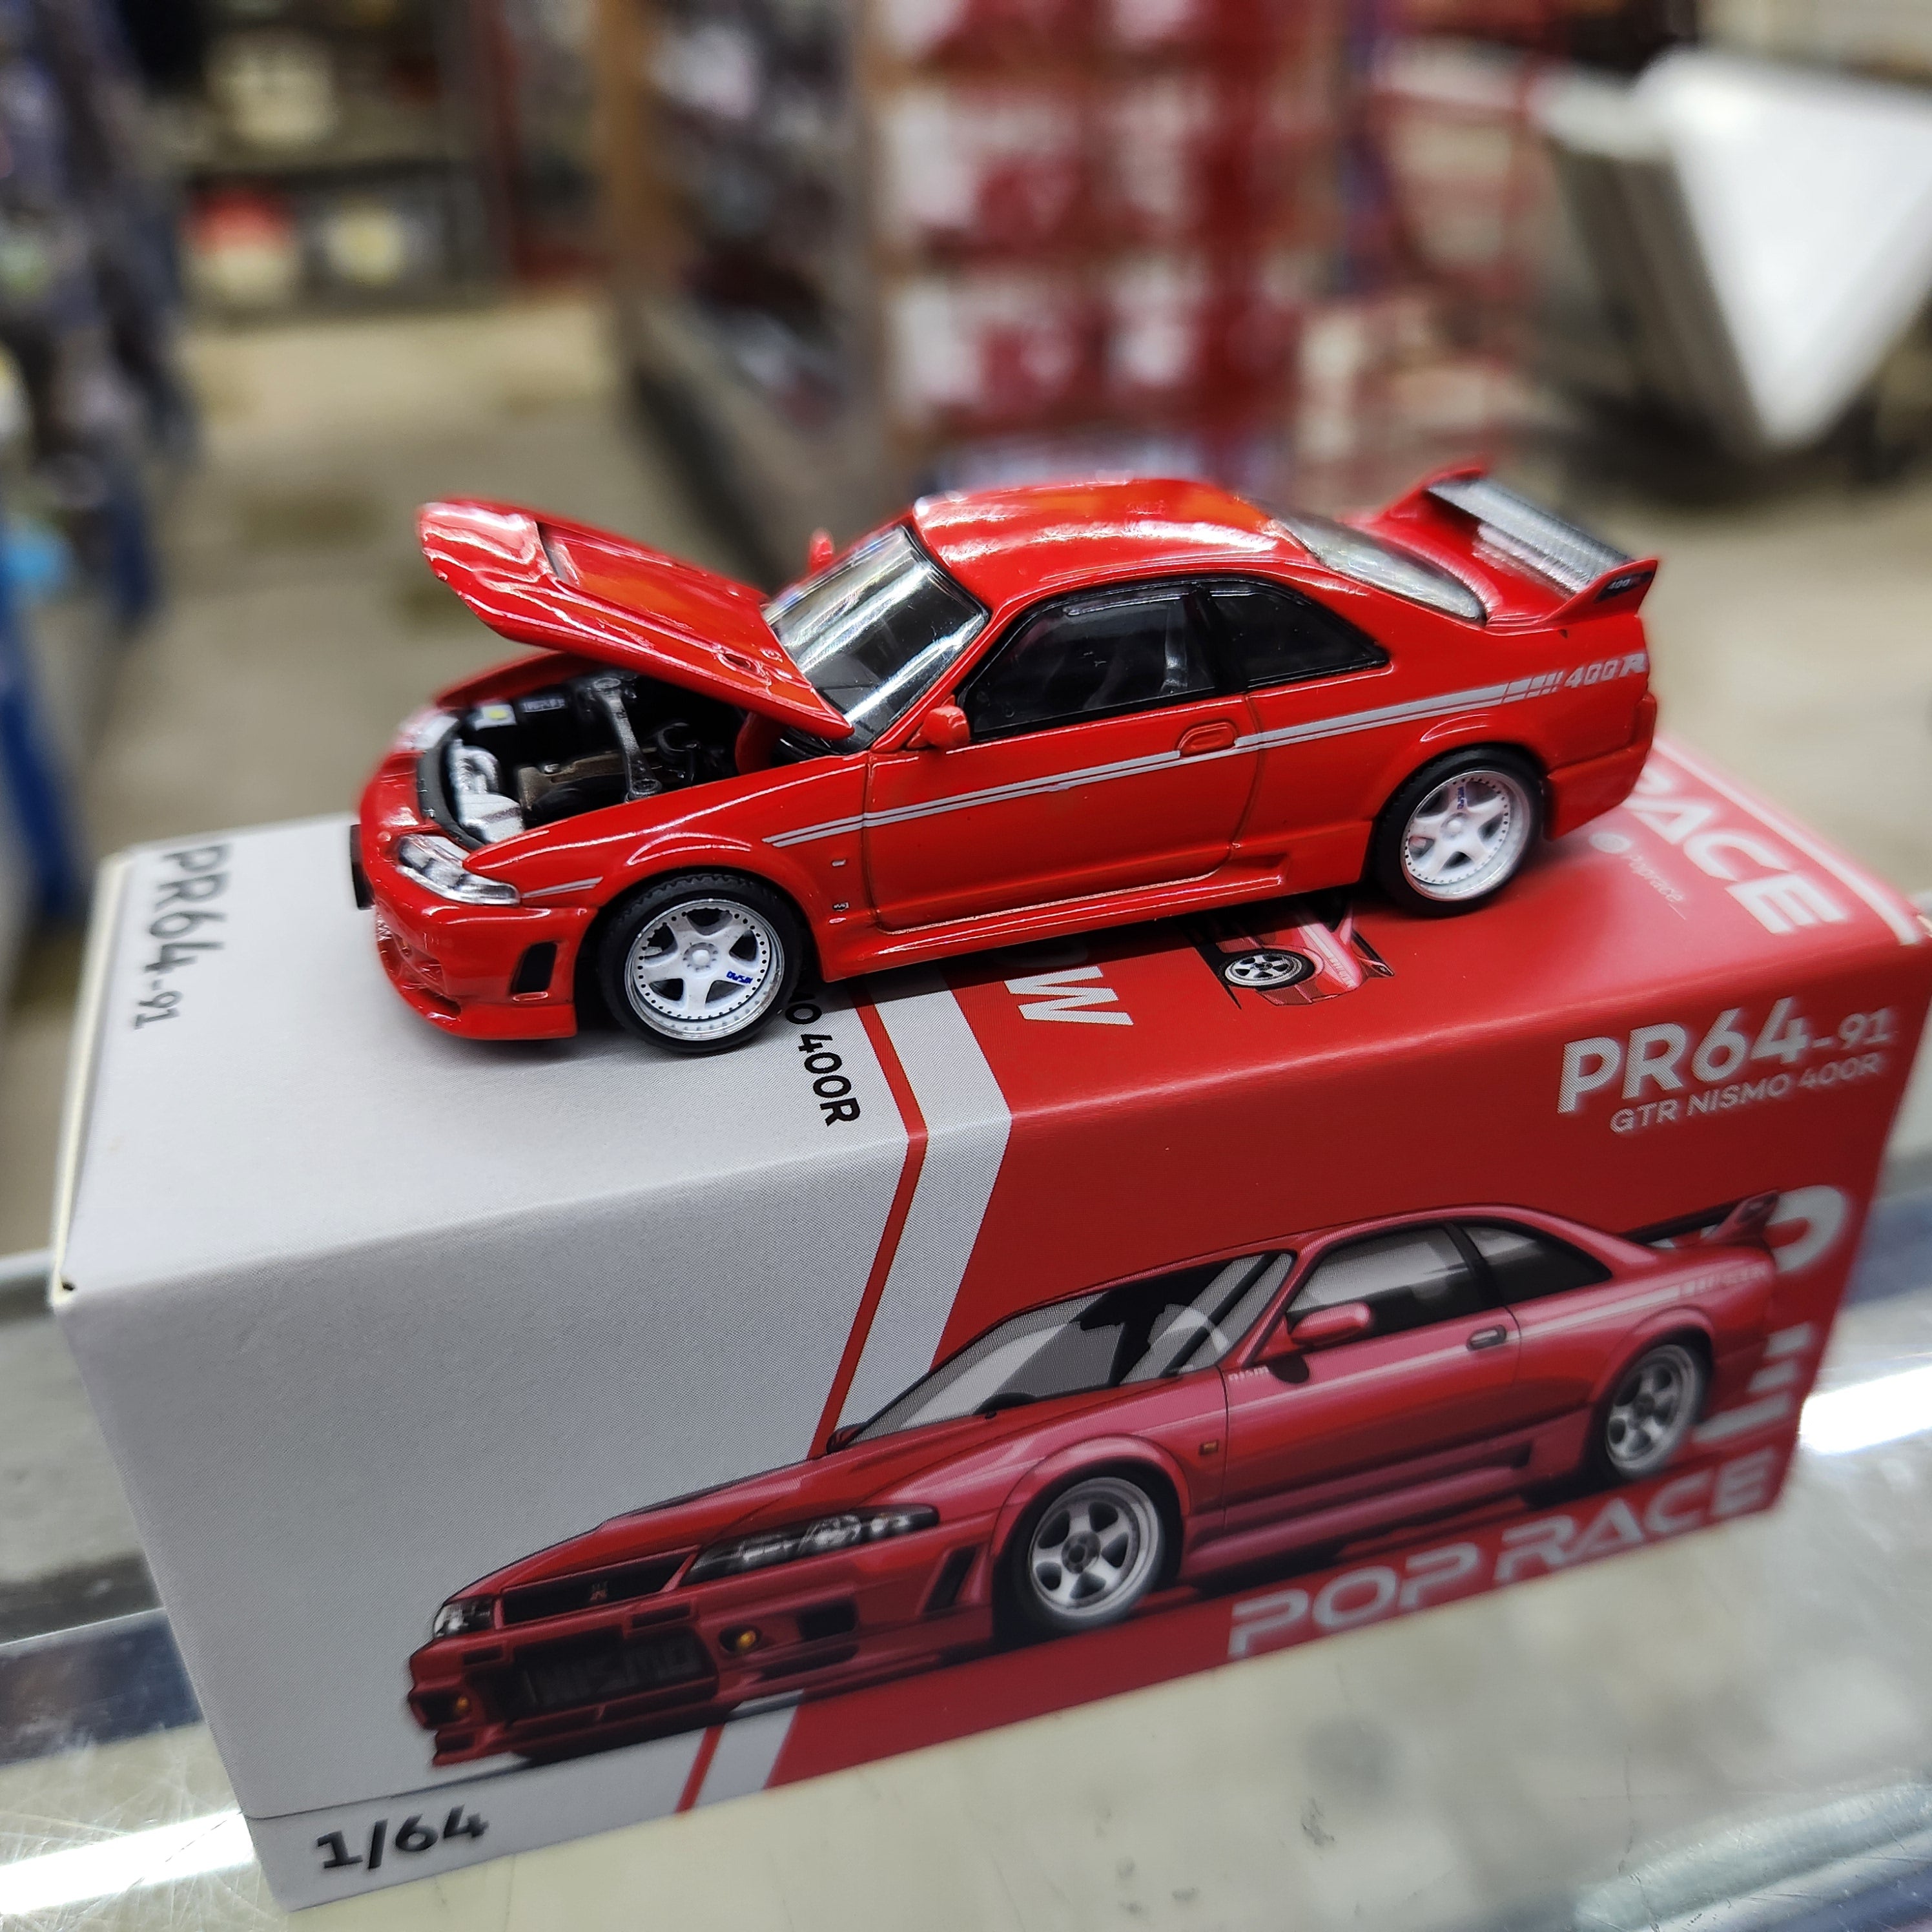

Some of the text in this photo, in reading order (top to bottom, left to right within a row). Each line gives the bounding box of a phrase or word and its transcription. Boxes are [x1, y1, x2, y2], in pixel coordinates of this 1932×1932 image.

[1564, 653, 1645, 689] 400R
[131, 843, 232, 1031] PR64-91
[798, 1034, 860, 1127] 400R
[1557, 996, 1893, 1114] PR64-91
[1610, 1052, 1882, 1133] GTR NISMO 400R
[1228, 1449, 1776, 1658] POP RACE
[317, 1805, 489, 1871] 1/64
